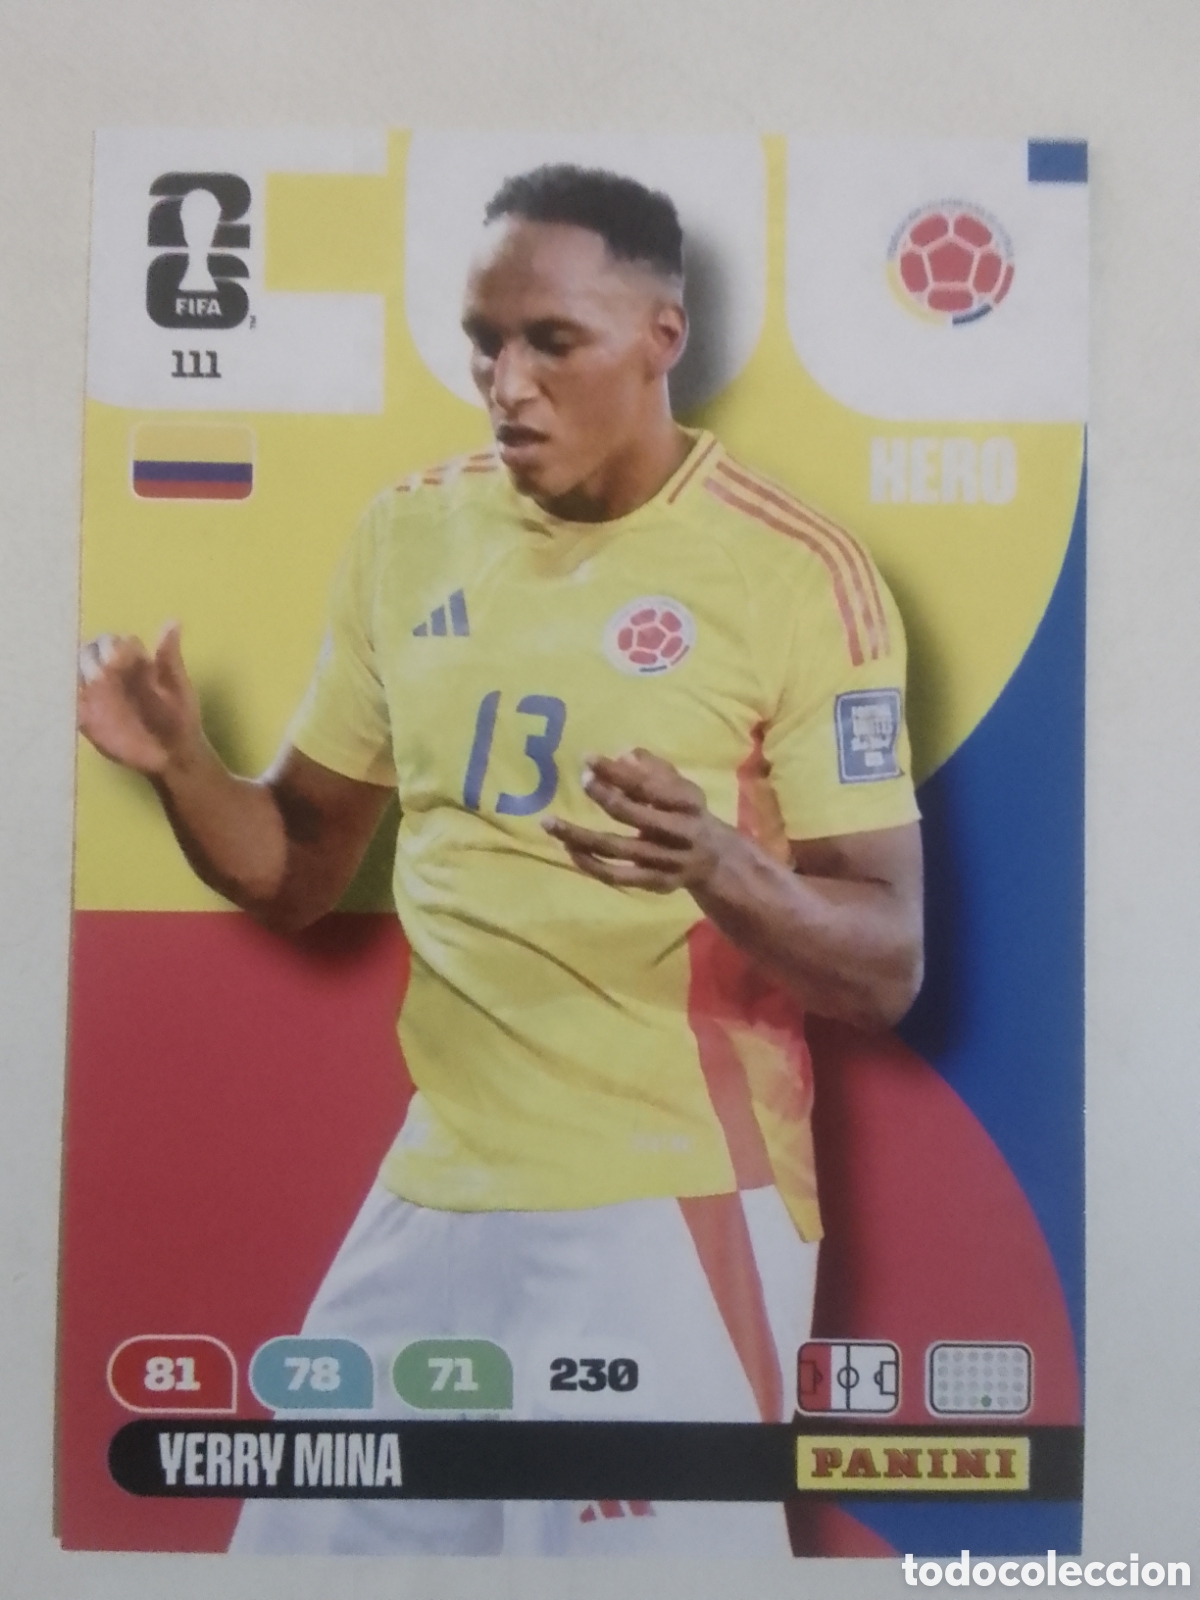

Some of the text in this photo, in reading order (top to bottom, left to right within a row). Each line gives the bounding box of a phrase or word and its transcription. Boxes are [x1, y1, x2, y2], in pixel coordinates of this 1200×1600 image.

[174, 297, 223, 316] FIFA
[171, 349, 222, 378] 111
[869, 436, 1018, 505] HERO
[462, 690, 567, 817] 13
[143, 1356, 201, 1392] 81
[284, 1356, 341, 1392] 78
[427, 1357, 479, 1392] 71
[549, 1357, 639, 1392] 230
[158, 1432, 403, 1488] YERRY MINA
[811, 1447, 1018, 1480] PANINI
